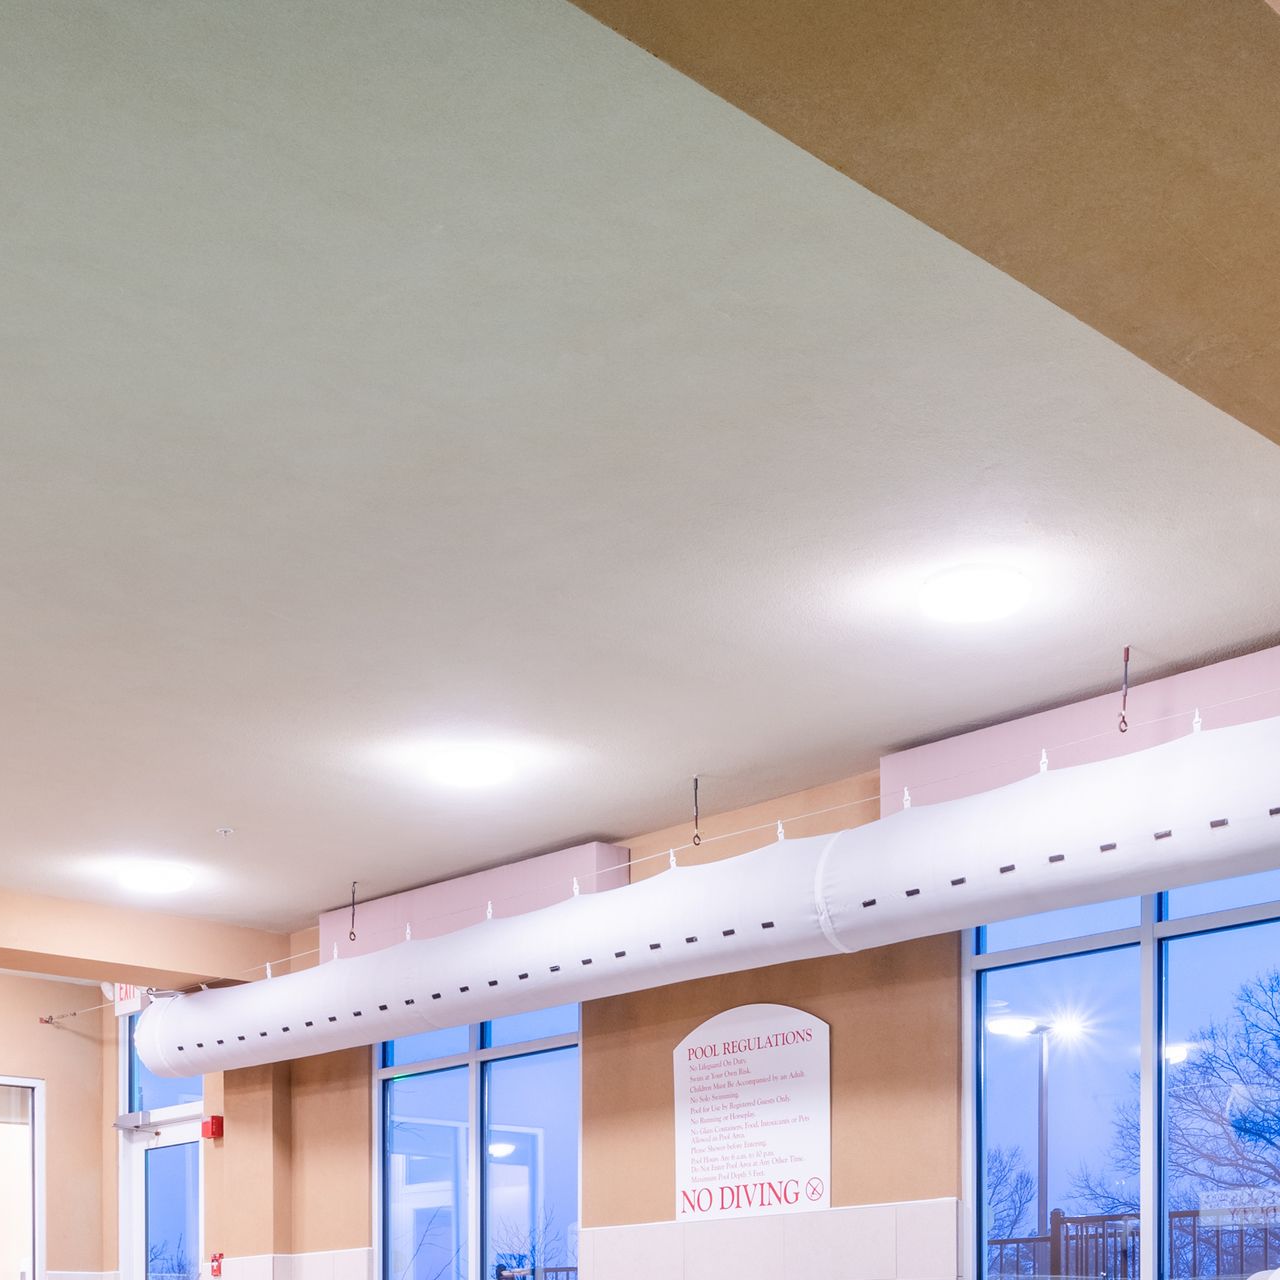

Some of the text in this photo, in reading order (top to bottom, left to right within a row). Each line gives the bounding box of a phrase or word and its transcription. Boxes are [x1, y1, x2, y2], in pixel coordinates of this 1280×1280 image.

[687, 1028, 813, 1061] POOL REGULATIONS
[681, 1179, 800, 1213] NO DIVING
